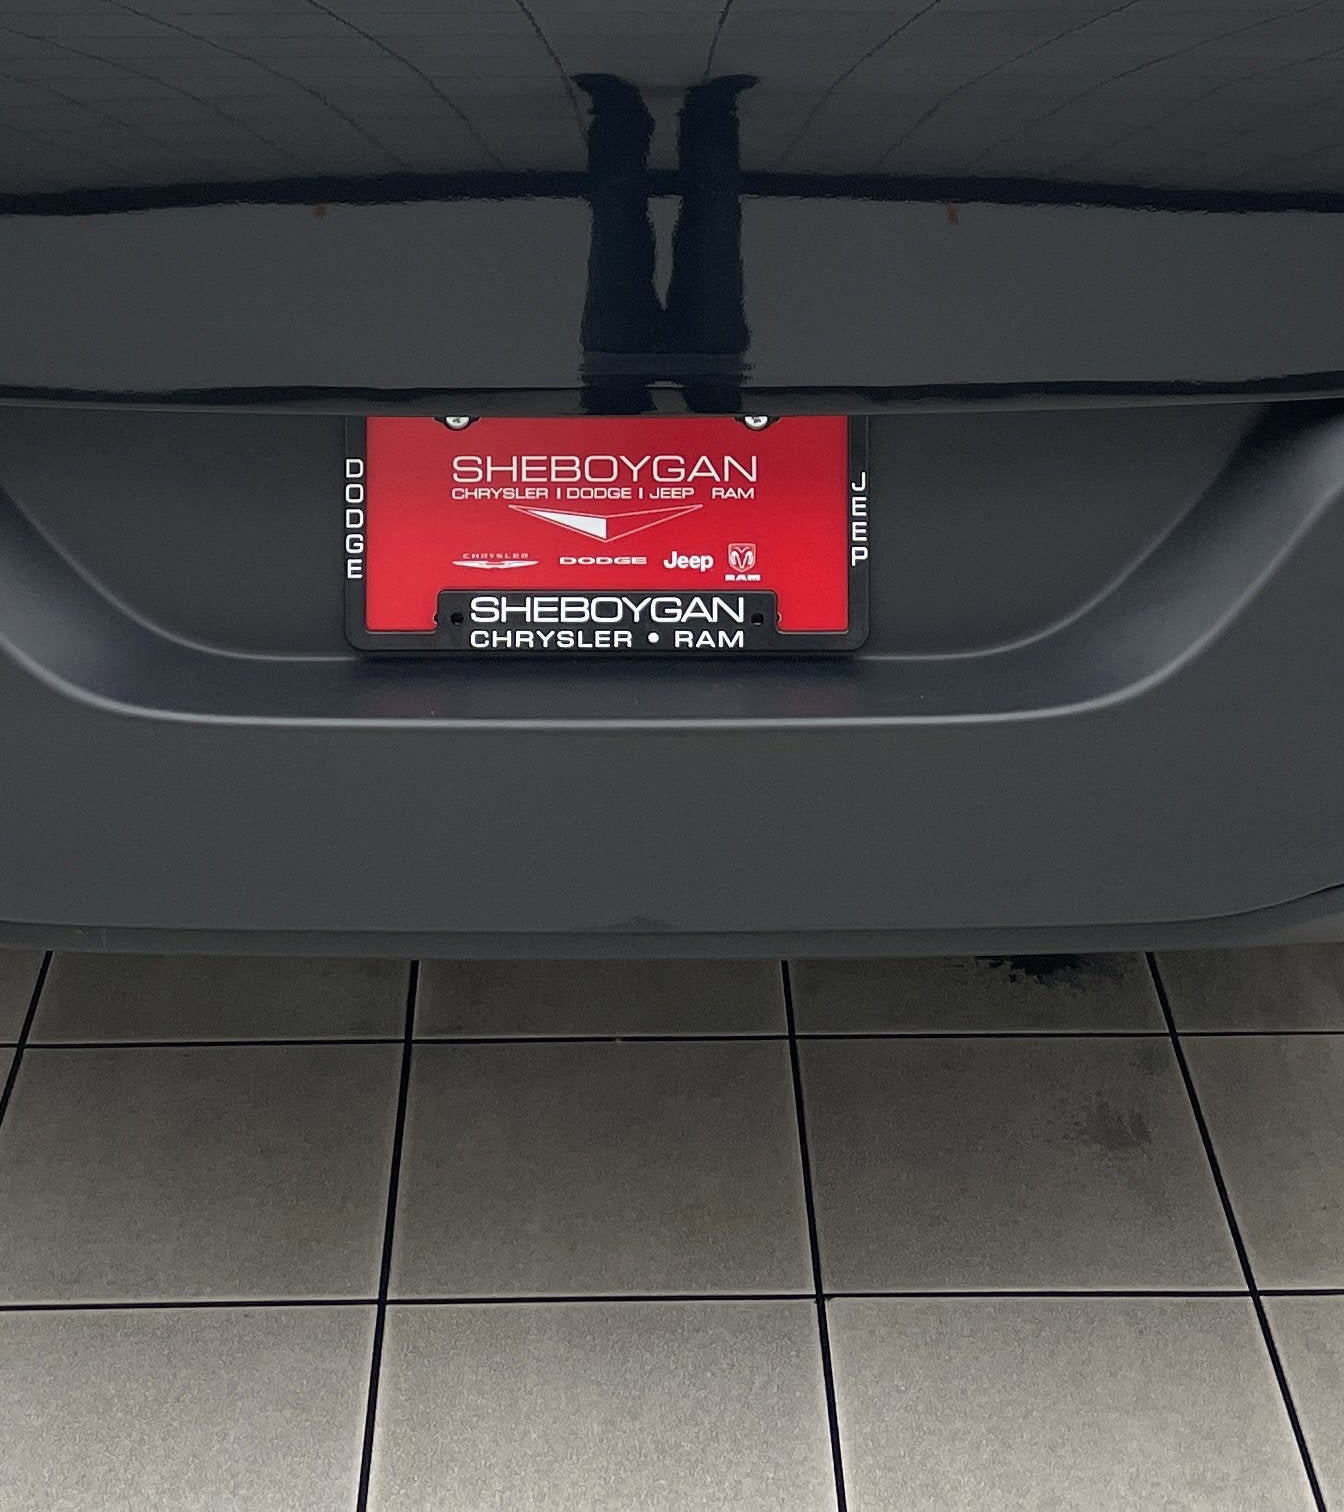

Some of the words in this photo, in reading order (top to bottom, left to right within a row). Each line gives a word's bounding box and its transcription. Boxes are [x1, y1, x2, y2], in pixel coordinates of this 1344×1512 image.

[451, 455, 758, 483] SHEBOYGAN
[451, 486, 550, 500] CHRYSLER
[566, 487, 632, 500] DODGE
[648, 487, 695, 500] JEEP
[711, 487, 755, 500] RAM
[345, 458, 364, 580] DODGE
[850, 471, 868, 567] JEEP
[559, 556, 648, 566] DODGE
[662, 550, 714, 573] Jeep
[724, 574, 761, 582] RAM
[469, 596, 745, 624] SHEBOYGAN
[470, 630, 633, 648] CHRYSLER
[674, 630, 745, 648] RAM
